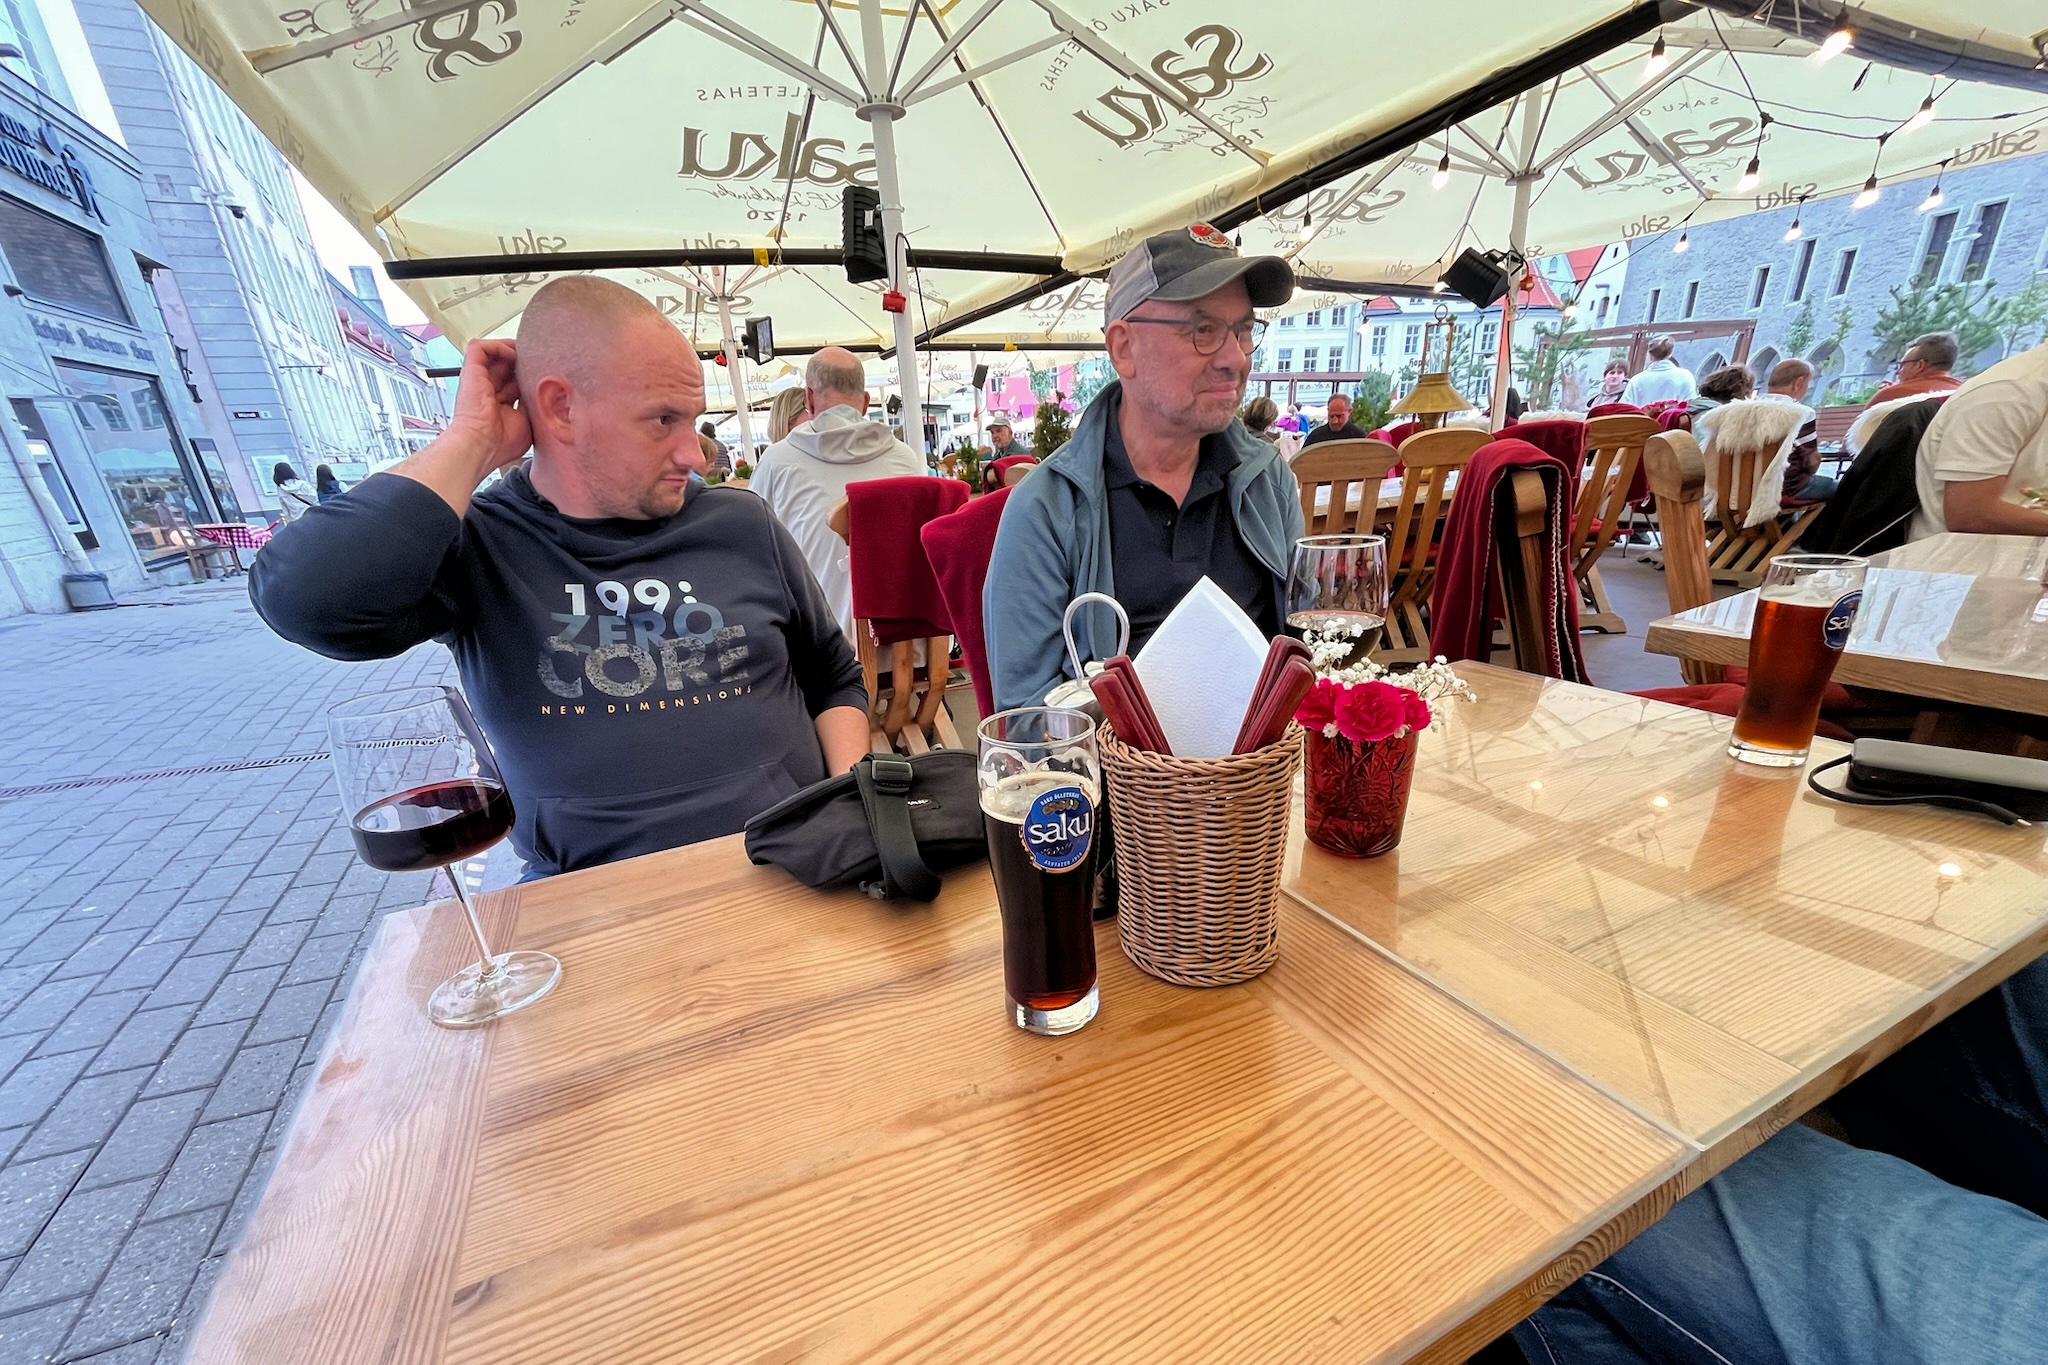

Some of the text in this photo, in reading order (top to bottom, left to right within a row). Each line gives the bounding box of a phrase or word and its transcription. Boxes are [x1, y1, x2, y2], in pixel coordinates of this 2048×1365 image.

[551, 602, 724, 653] ZERO
[537, 625, 750, 698] CORE
[541, 685, 752, 715] NEW DIMENSIONS
[1029, 812, 1090, 844] saku
